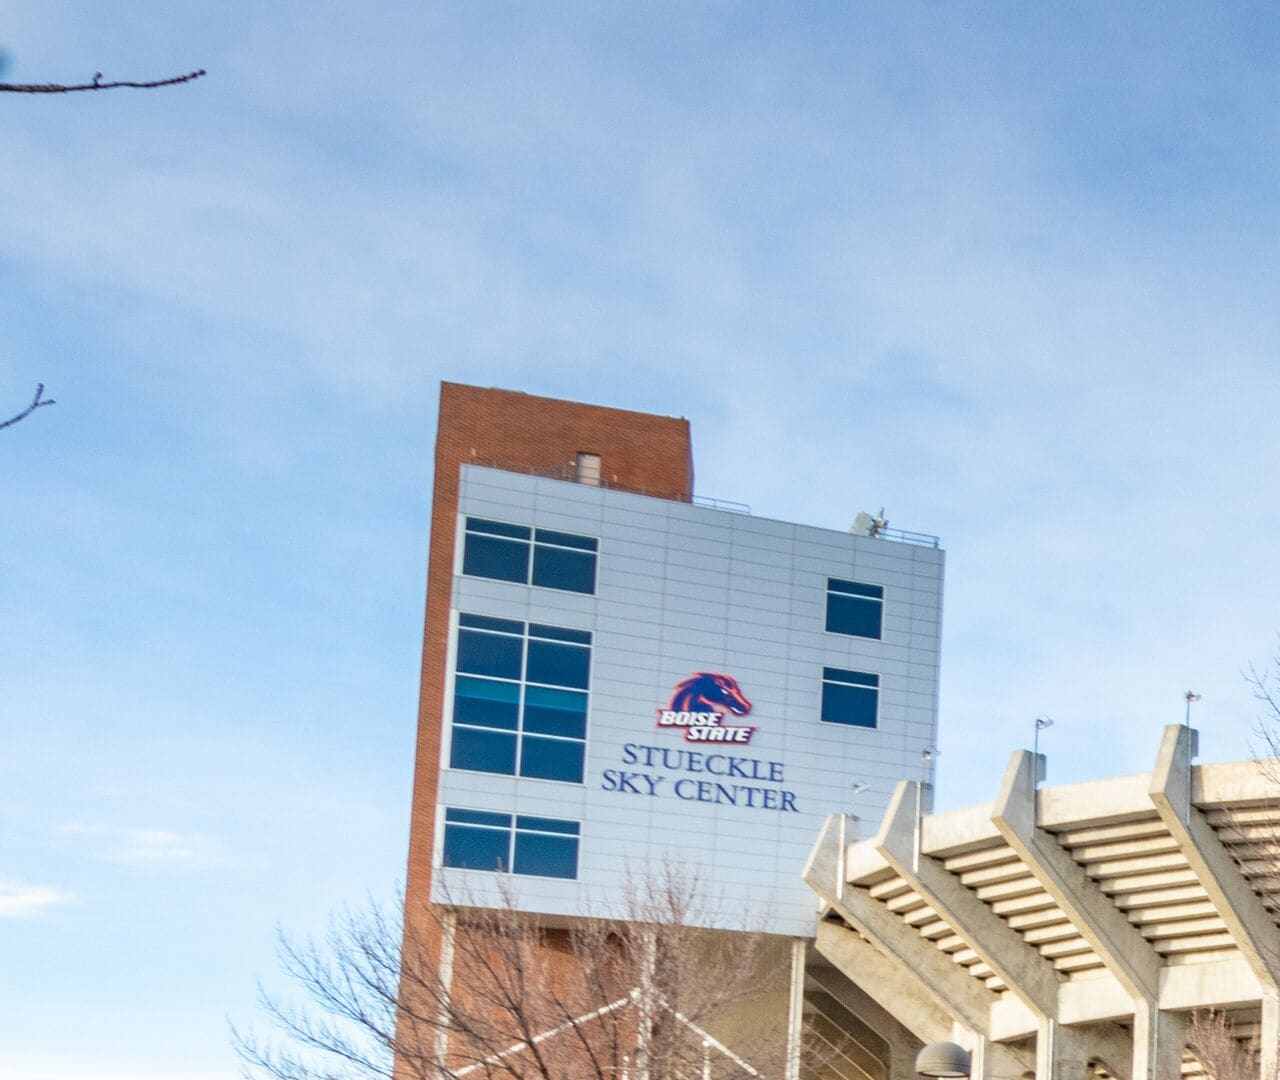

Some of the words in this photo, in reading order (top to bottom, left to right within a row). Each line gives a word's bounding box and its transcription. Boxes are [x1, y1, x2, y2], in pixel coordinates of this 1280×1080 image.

[659, 710, 722, 727] BOISE
[686, 726, 752, 743] STATE
[622, 743, 785, 783] STUECKLE
[601, 769, 665, 797] SKY
[674, 778, 800, 813] CENTER
